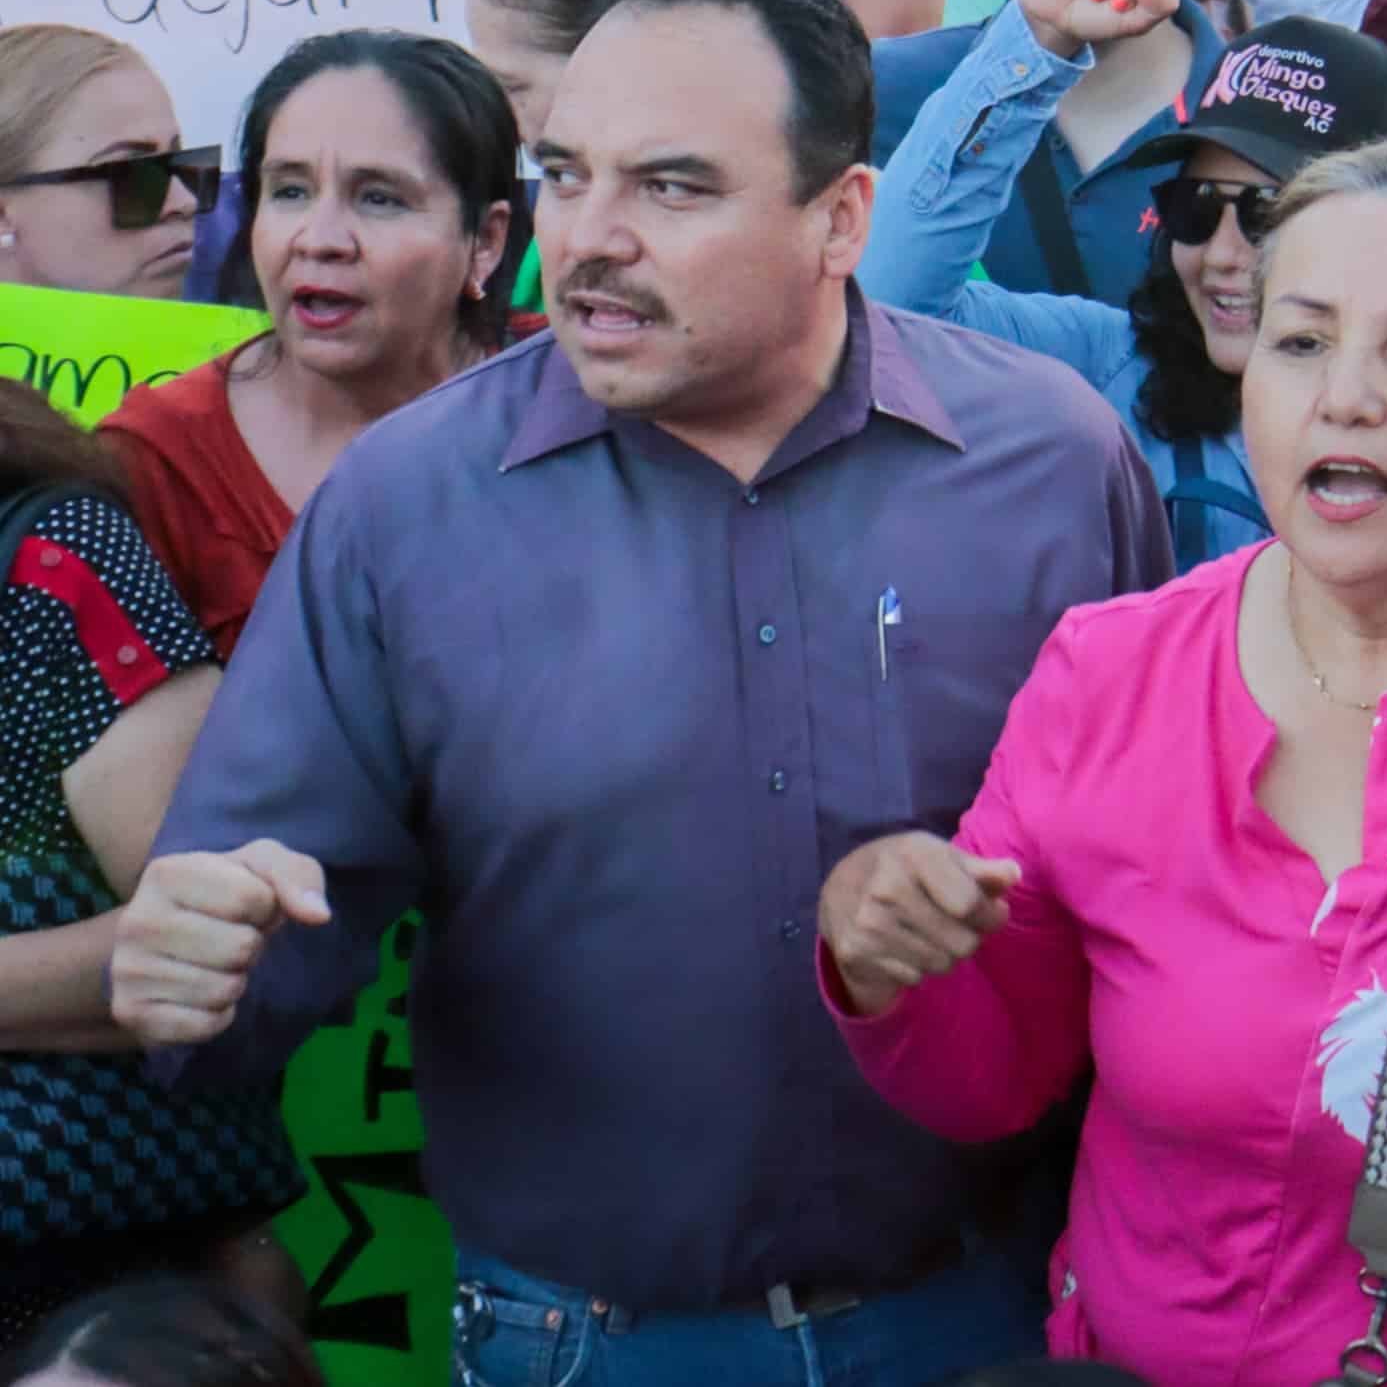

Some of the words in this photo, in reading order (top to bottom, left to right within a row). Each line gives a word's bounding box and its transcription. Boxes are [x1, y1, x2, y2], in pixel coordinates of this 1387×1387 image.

[1258, 45, 1325, 69] deportivo
[1247, 56, 1326, 91] Mingo
[1238, 75, 1337, 123] Vázquez
[1303, 115, 1330, 134] AC
